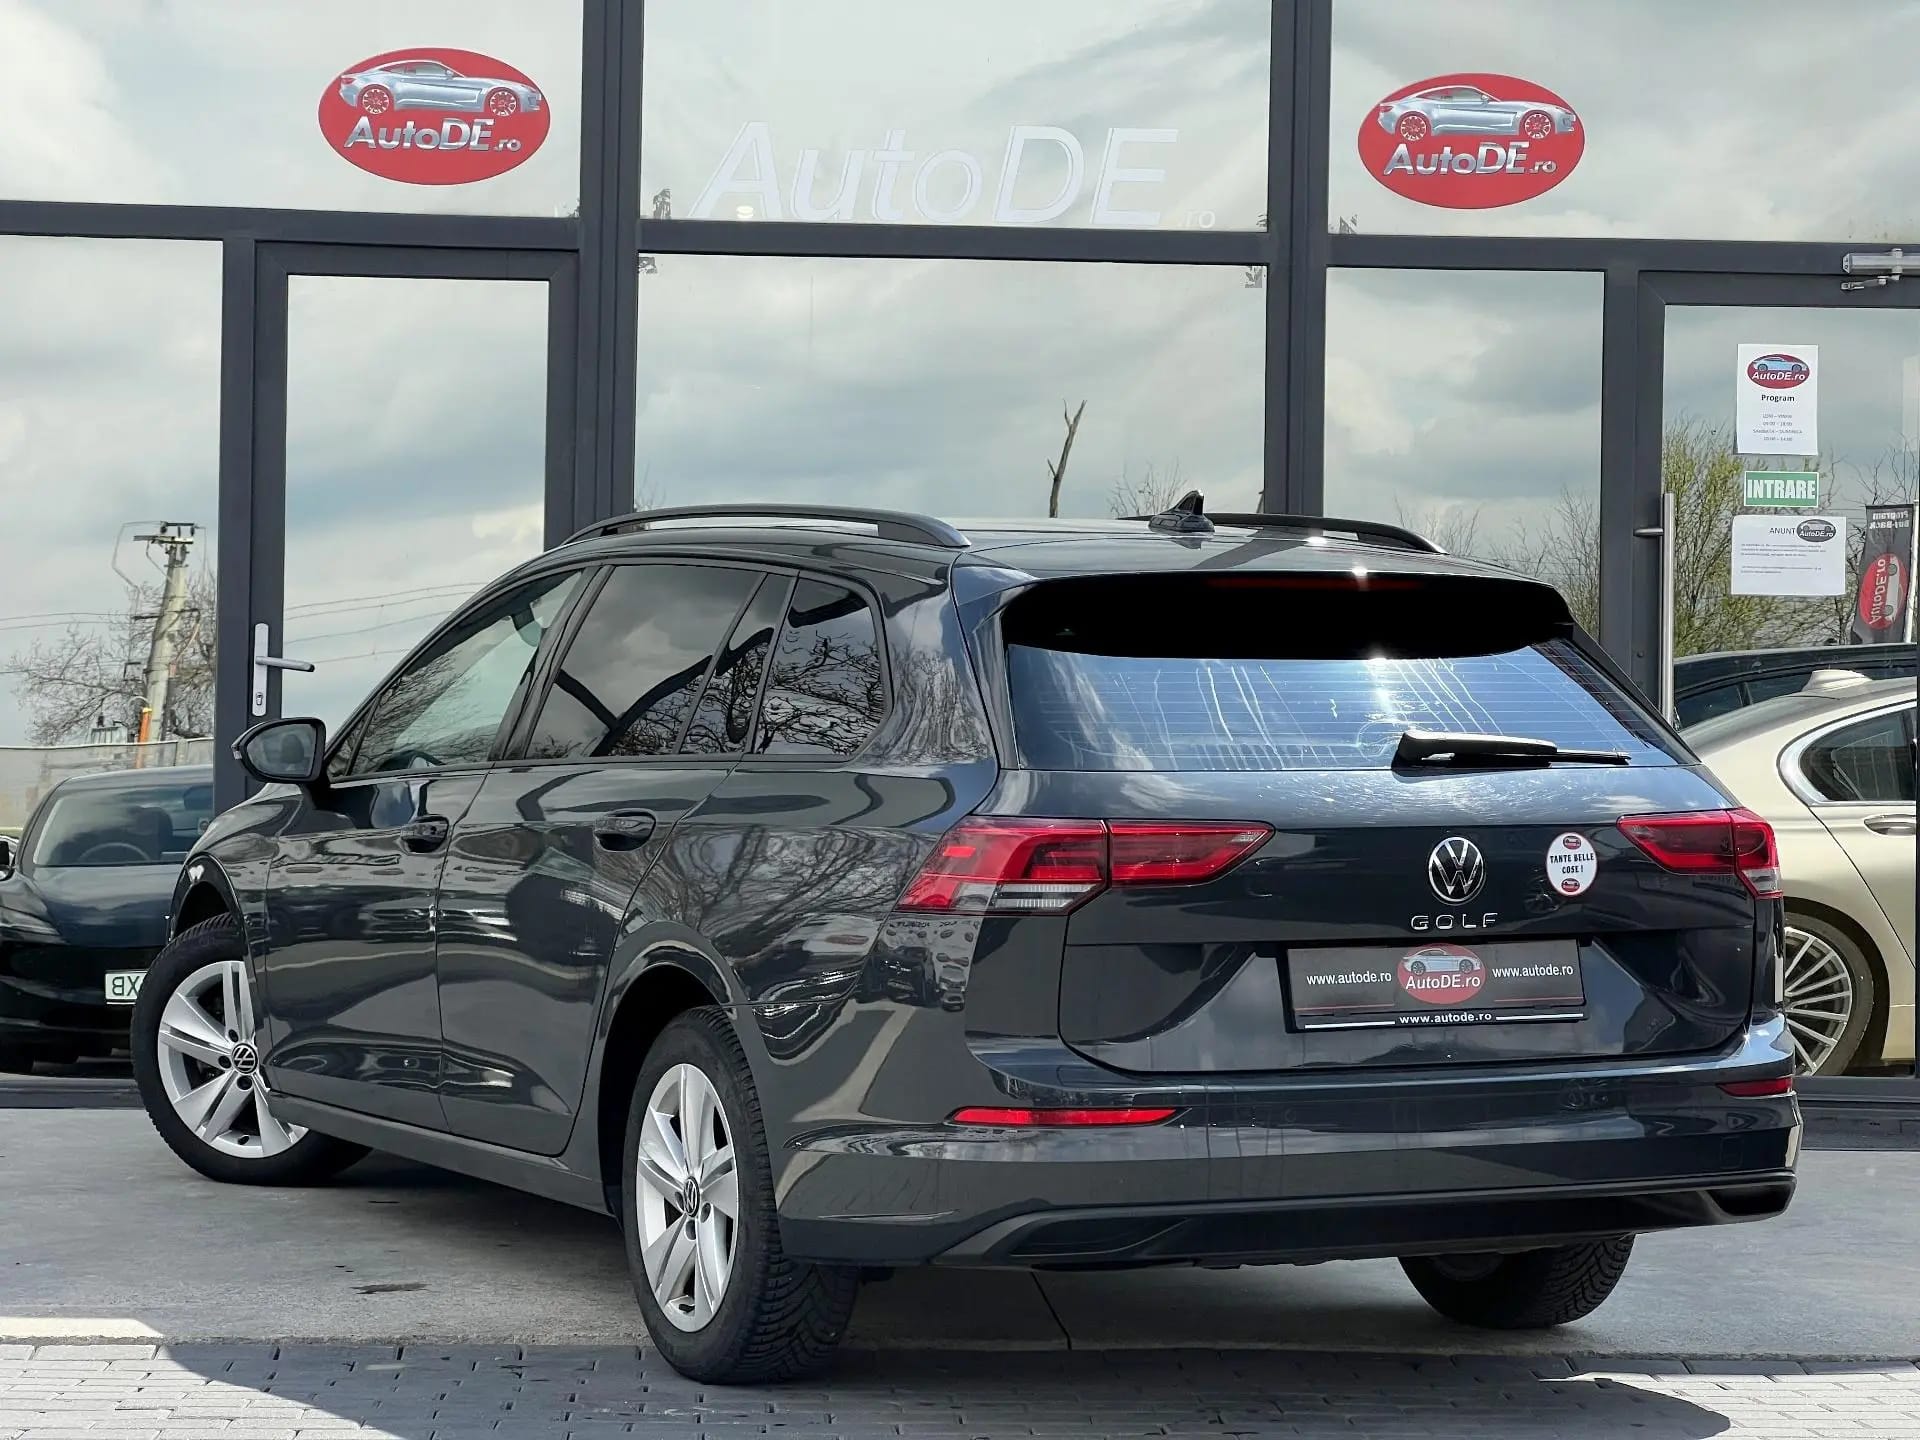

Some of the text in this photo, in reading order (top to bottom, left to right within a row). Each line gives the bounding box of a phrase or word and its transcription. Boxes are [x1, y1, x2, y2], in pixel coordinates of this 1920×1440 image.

[1752, 371, 1806, 381] AutoDE.ro
[1761, 394, 1795, 403] Program
[1747, 479, 1816, 500] INTRARE
[1799, 529, 1834, 538] AutoDE.ro
[1550, 852, 1595, 864] TANTE BELLE
[1410, 912, 1498, 931] GOLF
[1306, 970, 1392, 985] www.autode.ro
[1492, 963, 1574, 978] www.autode.ro
[1405, 973, 1481, 991] AutoDE.ro
[1399, 1011, 1493, 1025] www.autode.ro
